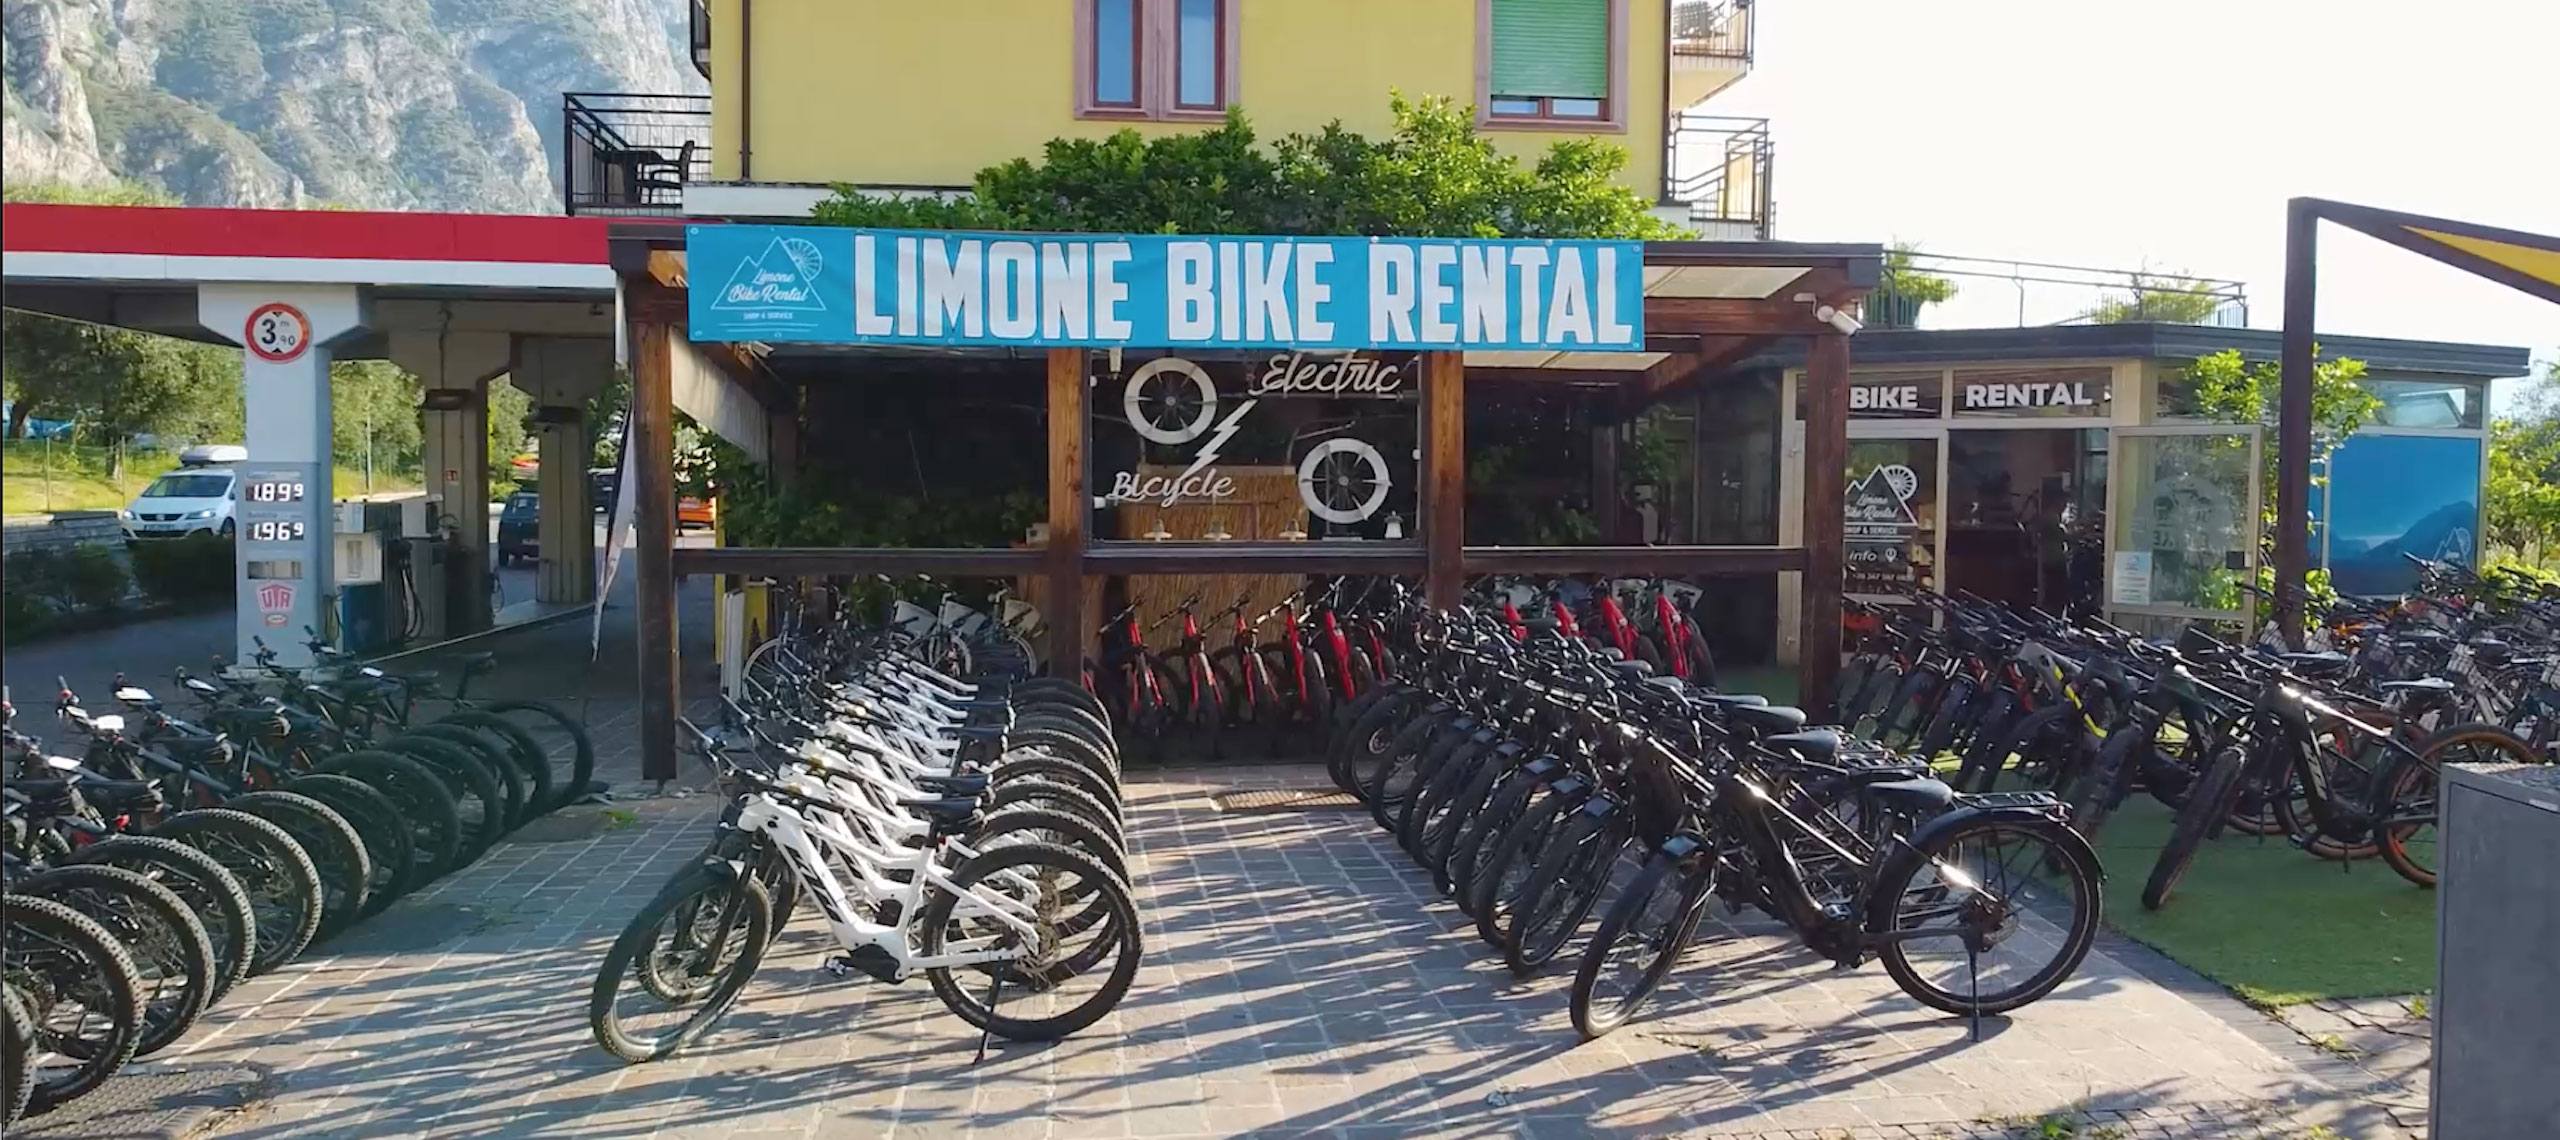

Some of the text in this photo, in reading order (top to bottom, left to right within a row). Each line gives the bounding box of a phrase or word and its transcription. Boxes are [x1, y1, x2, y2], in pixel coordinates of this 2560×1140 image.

[751, 267, 796, 284] Limone
[727, 283, 809, 304] Bike Rental
[854, 234, 1633, 345] LIMONE BIKE RENTAL
[1247, 353, 1402, 396] Electric
[1850, 382, 2093, 409] BIKE RENTAL
[1105, 468, 1237, 508] Bicycle
[1849, 550, 1877, 562] info
